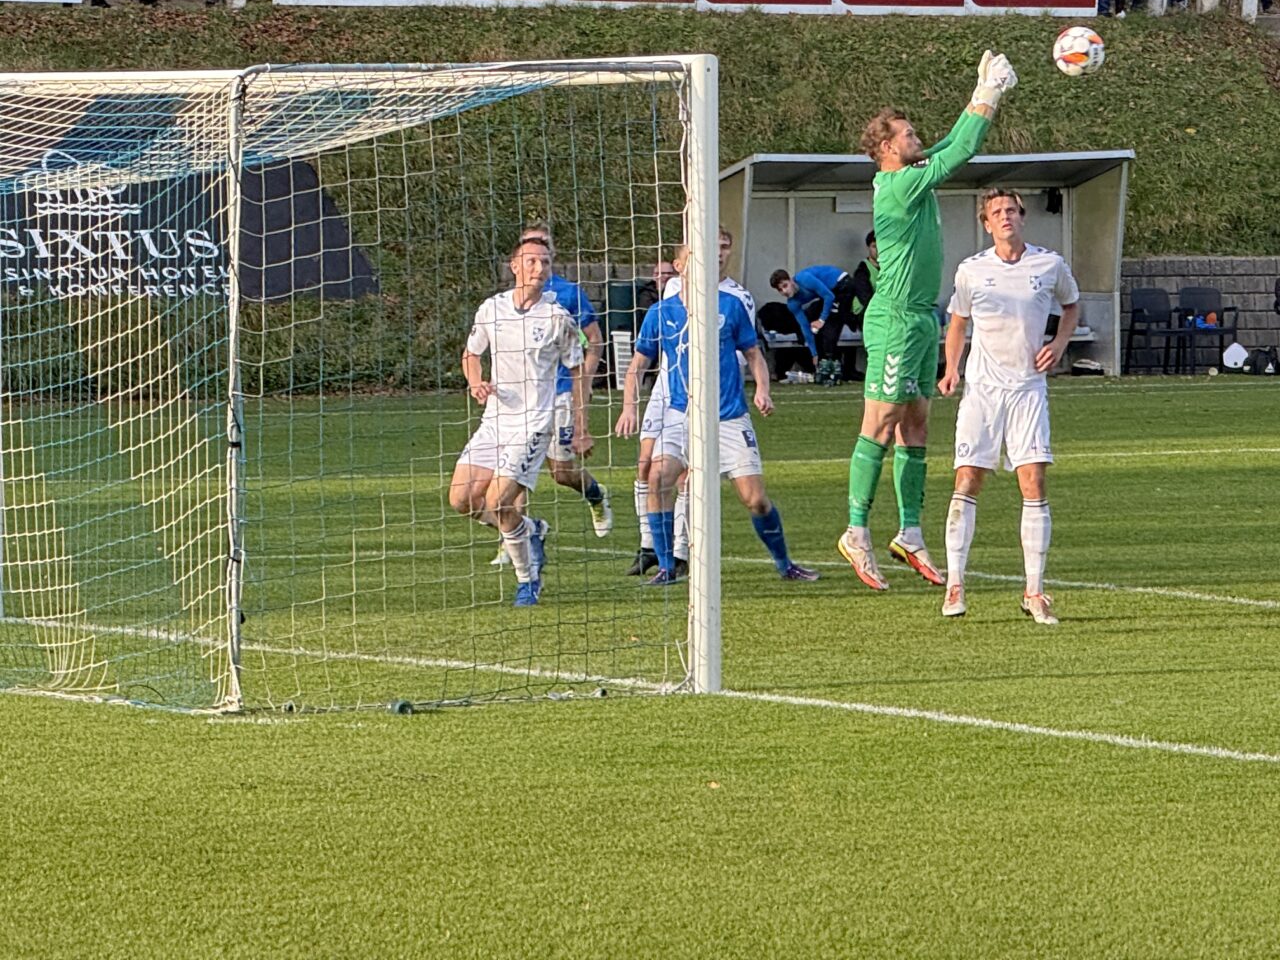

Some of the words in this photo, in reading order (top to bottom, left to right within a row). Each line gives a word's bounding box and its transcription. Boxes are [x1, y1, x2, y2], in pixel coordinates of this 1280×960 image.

[0, 228, 219, 260] SIXTUS
[4, 267, 128, 281] SINATUR
[139, 265, 231, 280] HOTEL
